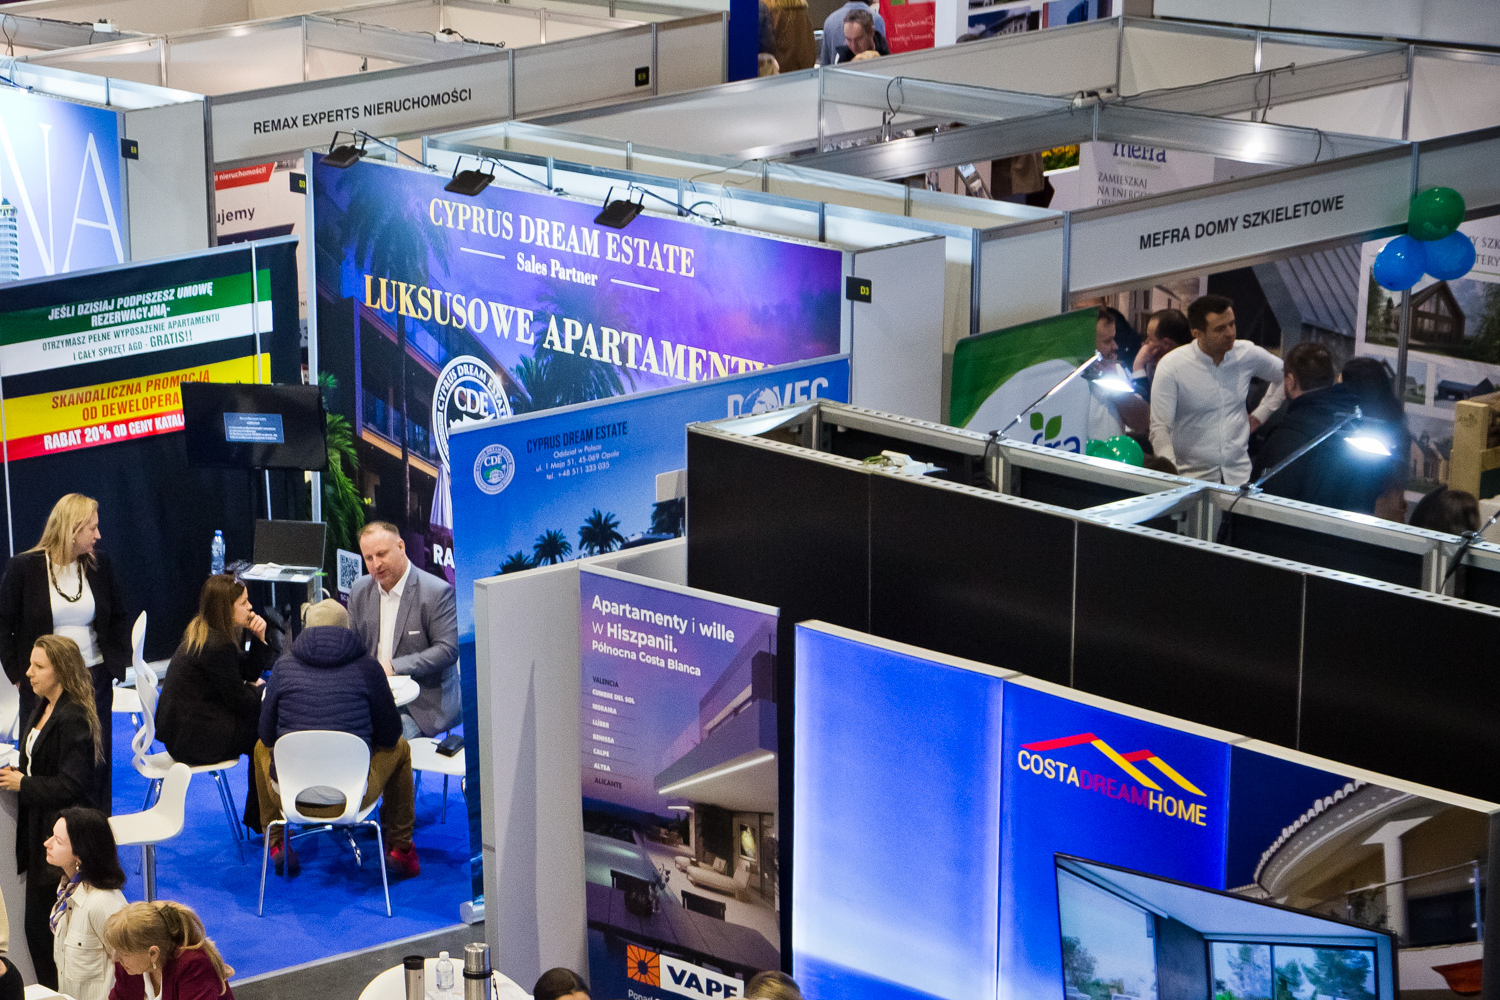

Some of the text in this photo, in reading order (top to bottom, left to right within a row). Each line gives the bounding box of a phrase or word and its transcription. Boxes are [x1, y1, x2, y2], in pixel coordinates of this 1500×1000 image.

[253, 88, 472, 134] REMAX EXPERTS NIERUCHOMOŚCI
[429, 198, 695, 278] CYPRUS DREAM ESTATE
[1140, 195, 1345, 250] MEFRA DOMY SZKIELETOWE
[517, 251, 598, 287] Sales Partner
[48, 282, 213, 321] JEŚLI DZISIAJ PODPISZESZ UMOWĘ
[364, 274, 534, 345] LUKSUSOWE
[42, 313, 220, 351] OTRZYMASZ PEŁNE WYPOSAŻENIE APARTAMENTU
[78, 331, 193, 361] CAŁY SPRZĘT AGD GRATIS!!
[52, 383, 142, 410] SKANDALICZNA
[82, 392, 180, 422] OD DEWELOPERA
[454, 386, 489, 416] CDE
[457, 364, 487, 383] DREAM
[487, 378, 508, 418] ESTAT
[43, 430, 82, 450] RABAT
[85, 425, 112, 443] 20%
[113, 423, 128, 437] OD
[130, 420, 153, 435] CENY
[527, 421, 628, 453] CYPRUS DREAM ESTATE
[484, 455, 502, 467] CDE
[592, 595, 688, 634] Apartamenty
[699, 621, 735, 643] wille
[592, 622, 678, 653] w Hiszpanii.
[592, 640, 701, 676] Północna Costa Blanca
[593, 676, 619, 688] VALENCIA
[594, 777, 622, 789] ALICANTE
[1018, 750, 1207, 826] COSTADREAMHOME
